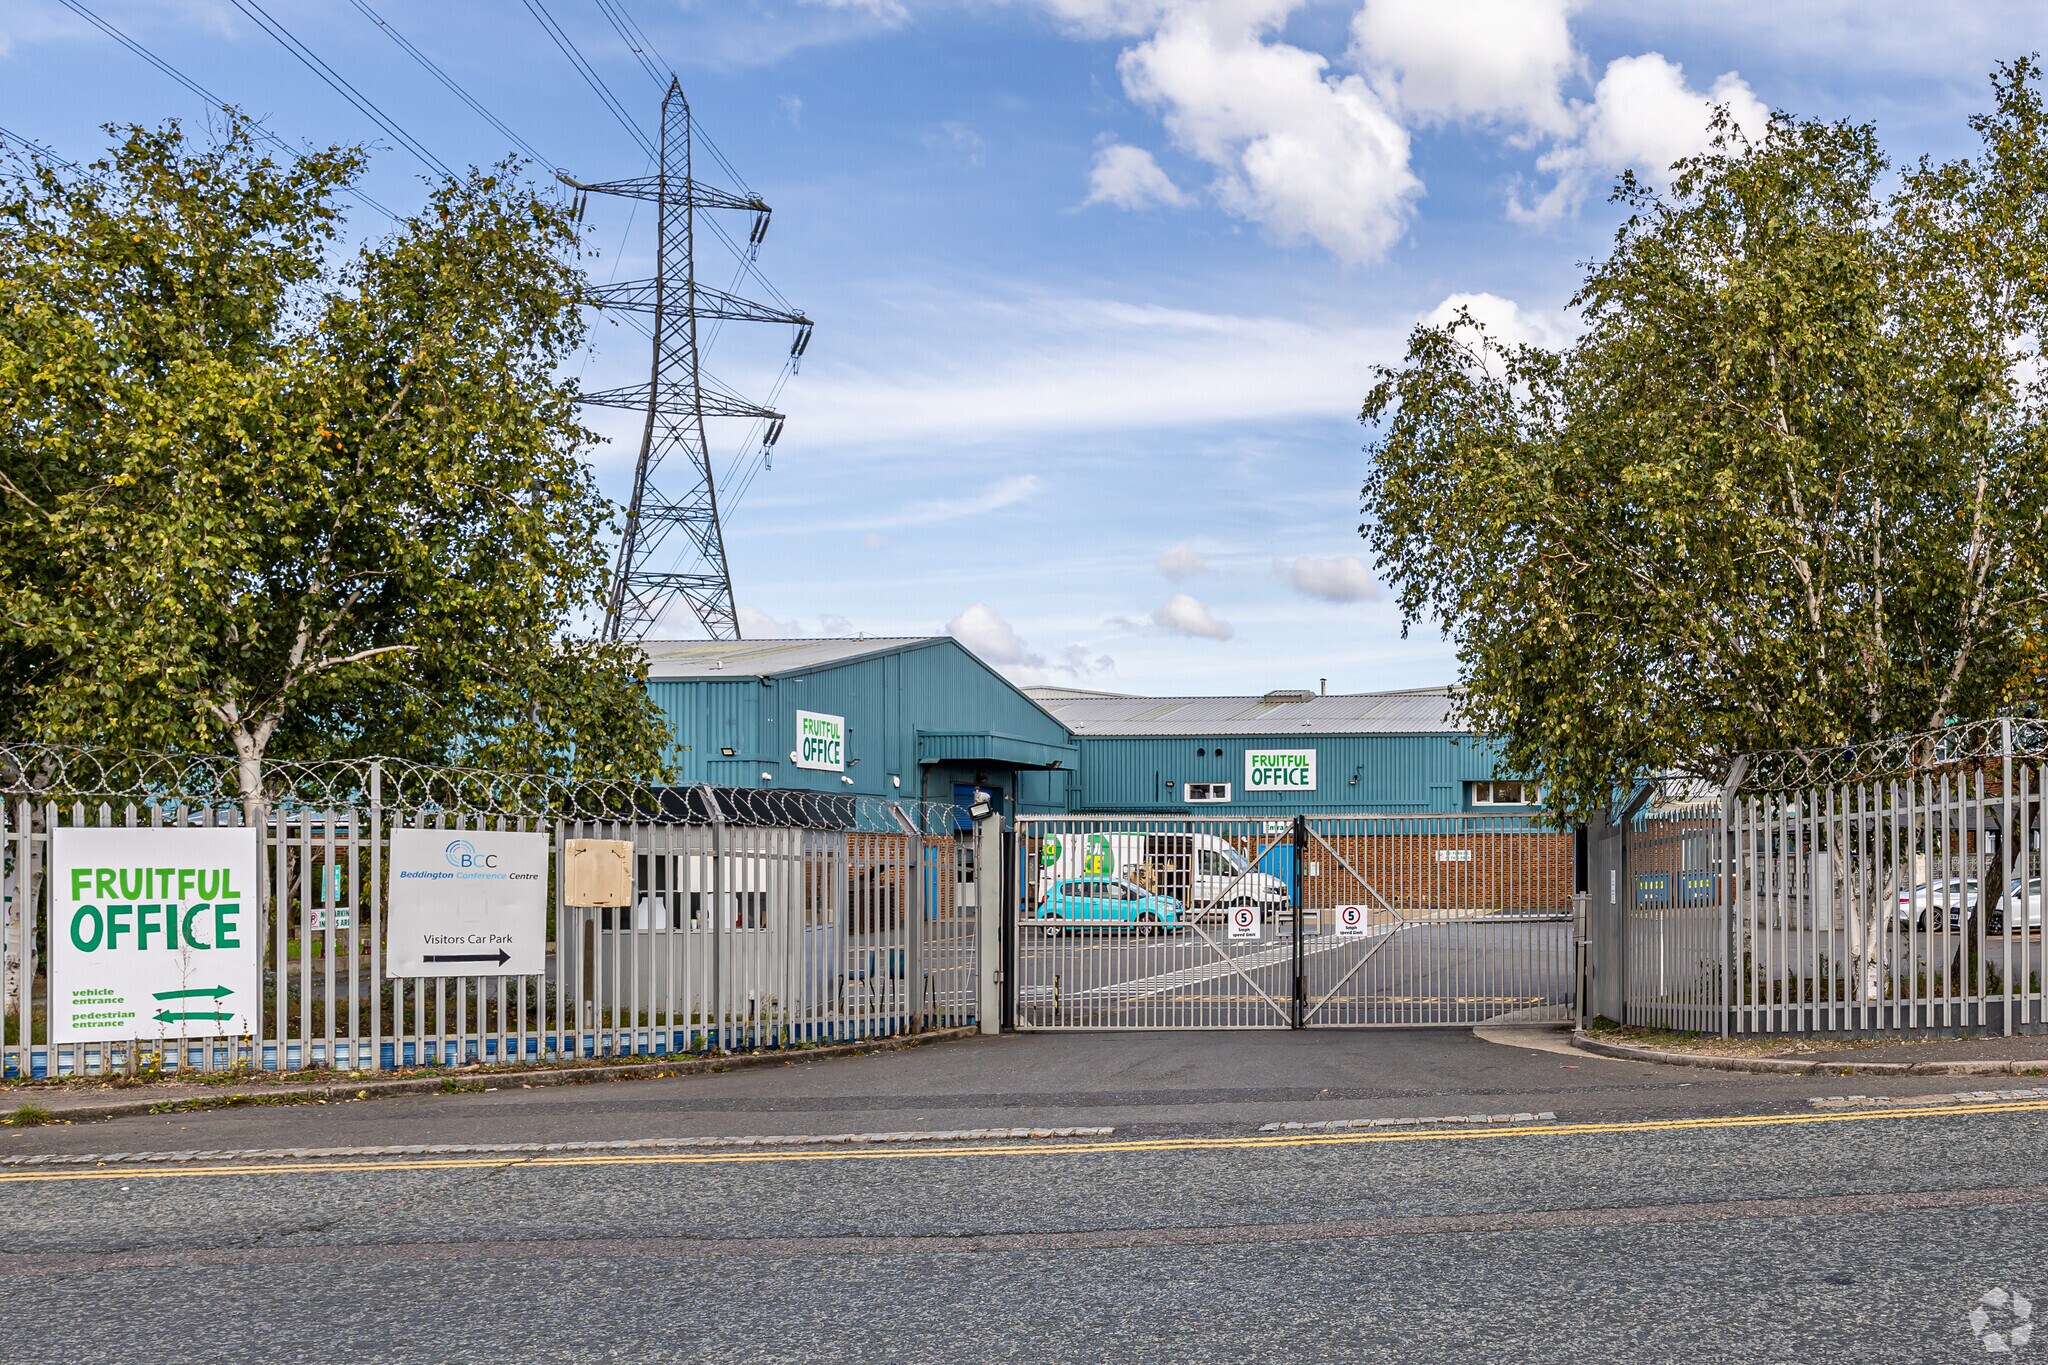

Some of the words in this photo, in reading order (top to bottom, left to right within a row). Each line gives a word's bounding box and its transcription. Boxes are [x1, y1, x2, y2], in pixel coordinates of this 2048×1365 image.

[803, 718, 840, 739] FRUITFUL
[803, 737, 840, 764] OFFICE
[1252, 755, 1309, 767] FRUITFUL
[1252, 768, 1309, 785] OFFICE
[461, 854, 498, 868] BCC
[400, 871, 454, 880] Beddington
[456, 871, 507, 880] Conference
[509, 872, 539, 880] Centre
[71, 867, 241, 901] FRUITFUL
[1241, 913, 1247, 922] 5
[1348, 911, 1354, 921] 5
[70, 903, 241, 952] OFFICE
[424, 935, 465, 944] Visitors
[468, 934, 486, 944] Car
[489, 934, 513, 944] Park
[72, 988, 114, 997] vehicle
[72, 996, 124, 1005] entrance
[72, 1011, 136, 1020] pedestrian
[72, 1019, 124, 1028] entrance
